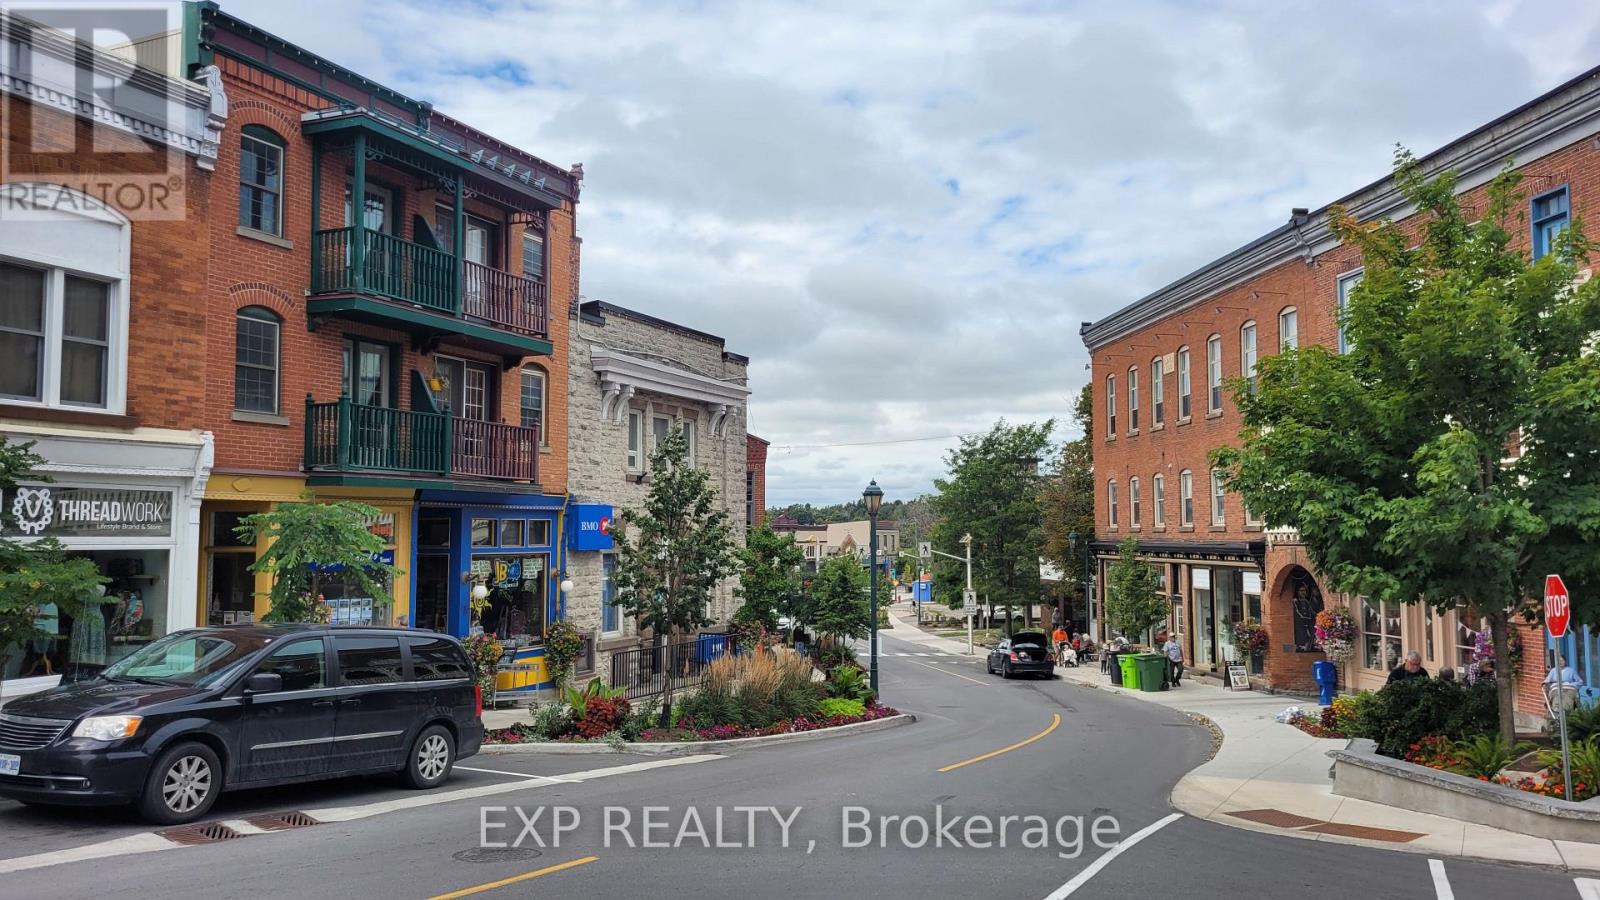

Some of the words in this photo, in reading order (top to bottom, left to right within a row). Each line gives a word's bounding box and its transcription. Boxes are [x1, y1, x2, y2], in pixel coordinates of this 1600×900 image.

[59, 500, 163, 522] THREADWORK
[581, 521, 598, 531] BMO
[1546, 594, 1567, 617] STOP
